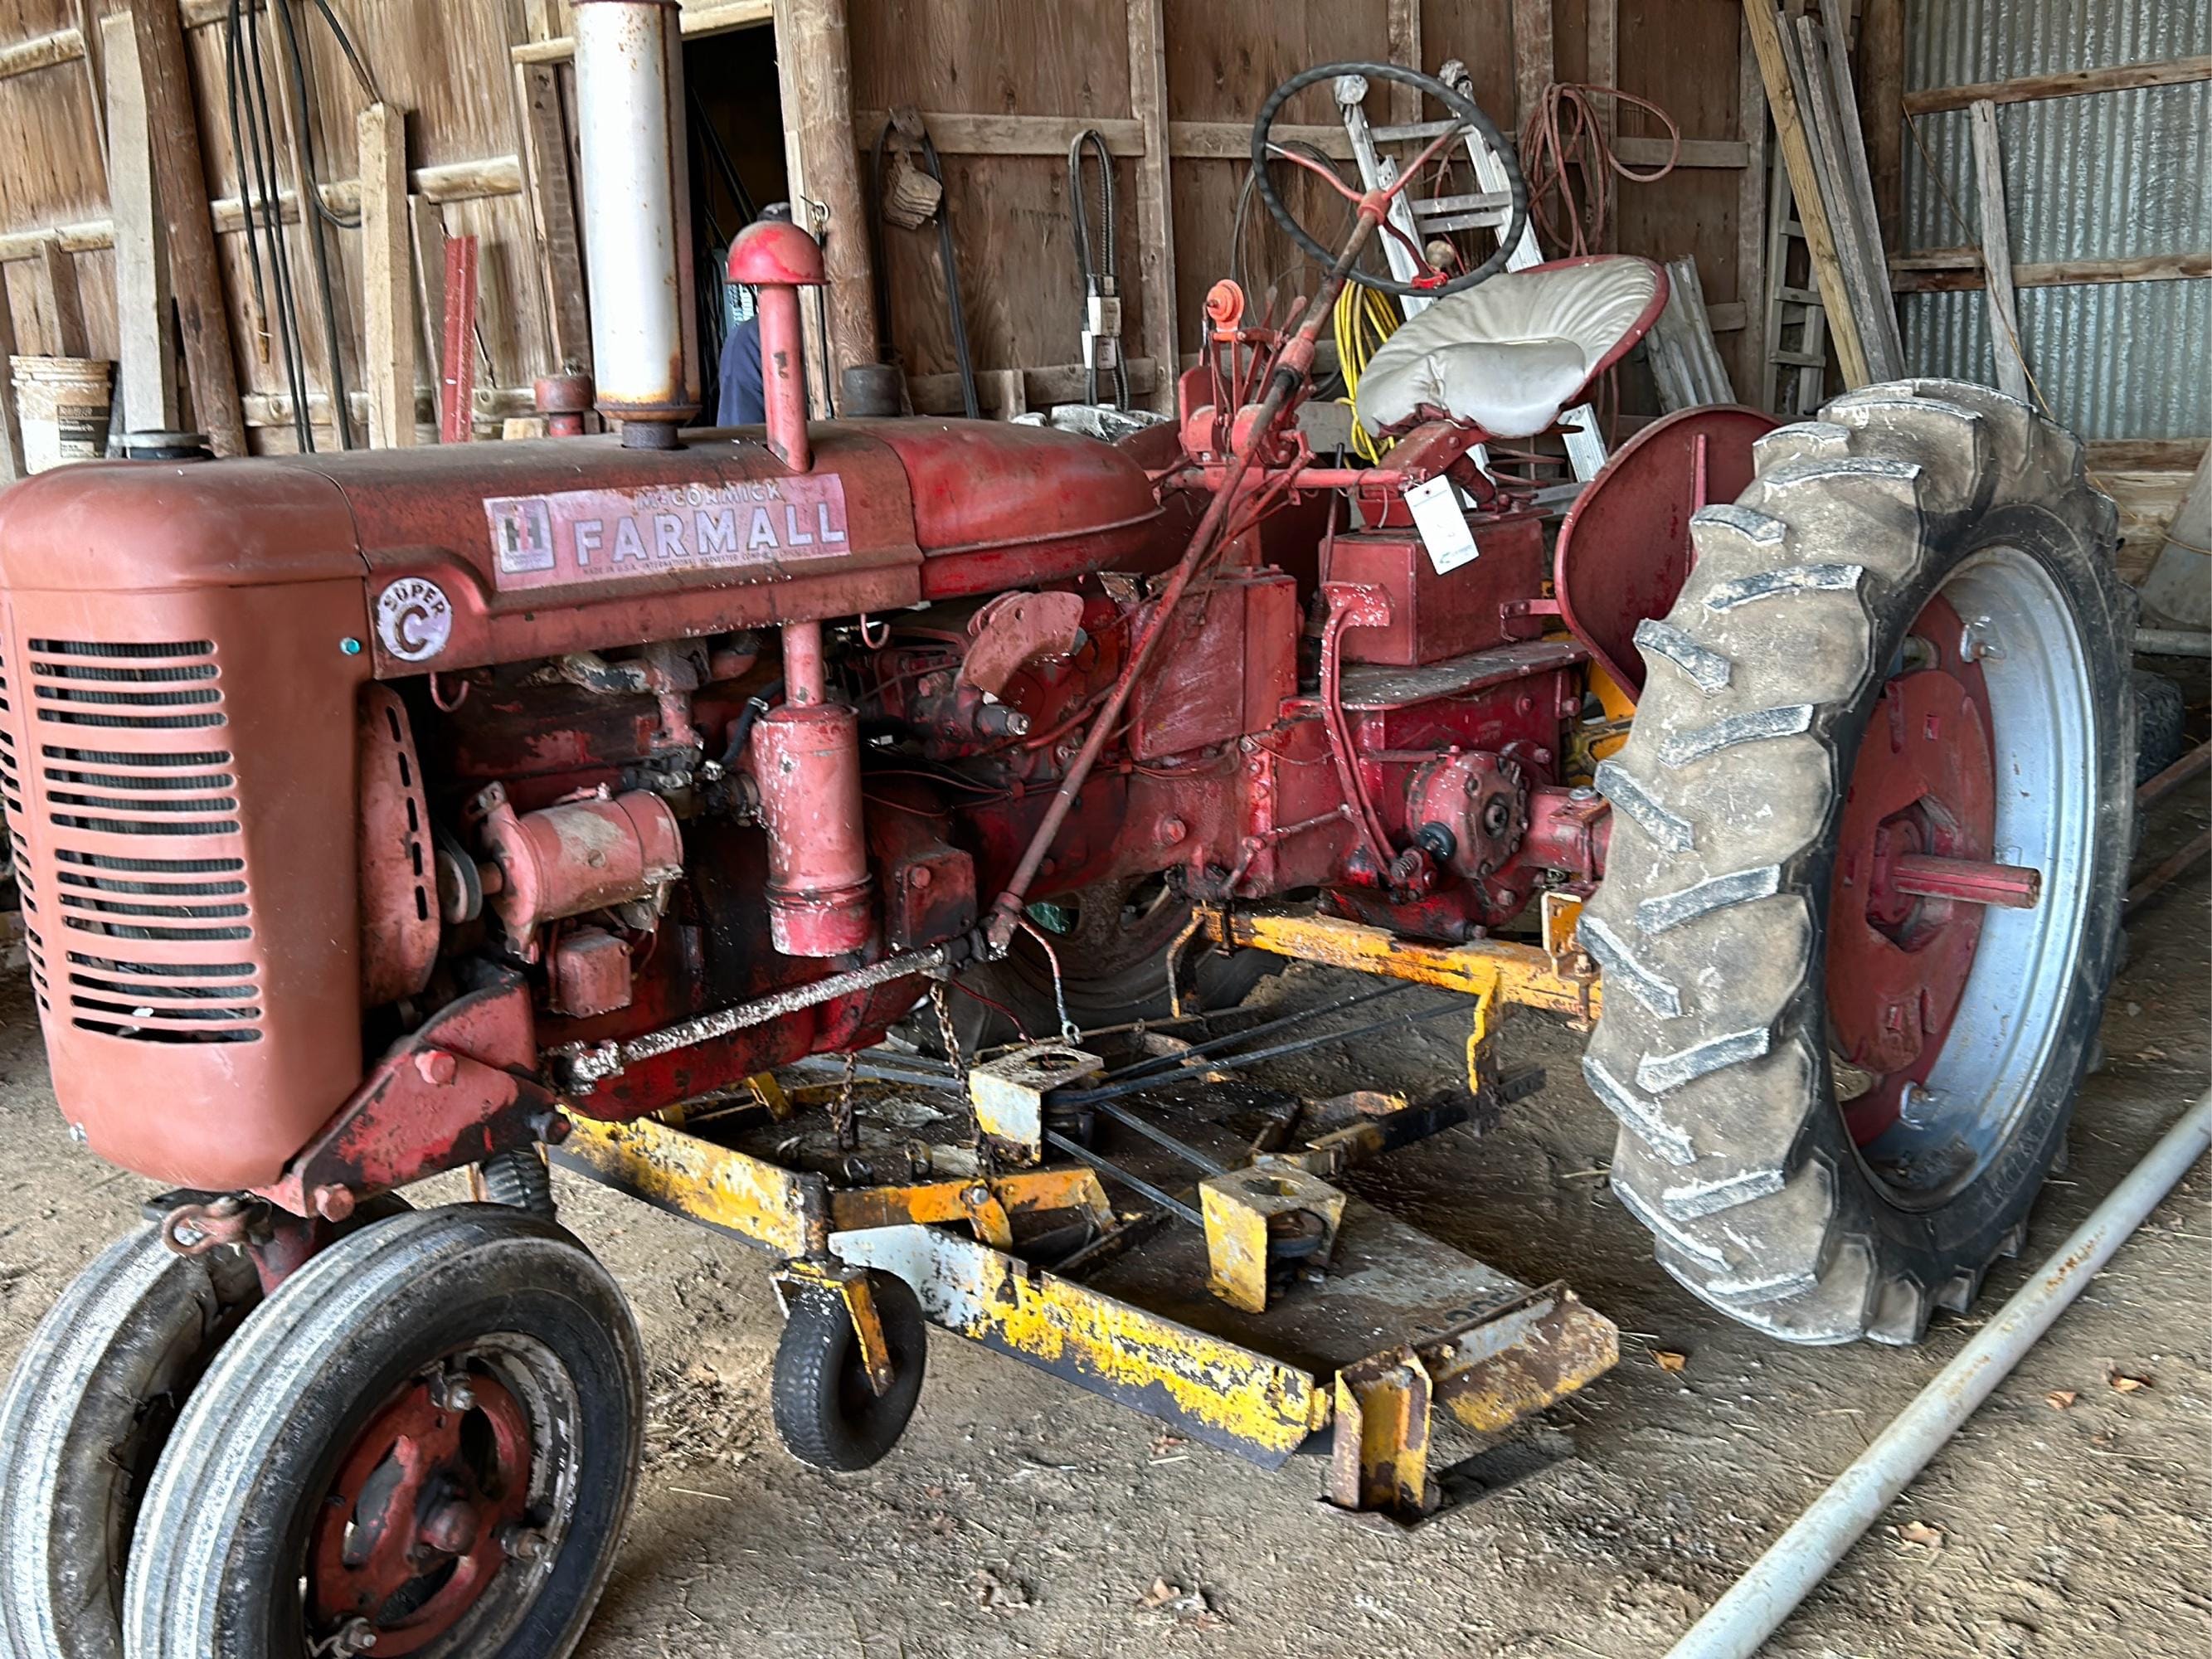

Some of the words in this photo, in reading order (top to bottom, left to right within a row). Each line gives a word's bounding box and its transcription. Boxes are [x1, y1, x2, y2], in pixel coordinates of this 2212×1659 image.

[574, 504, 845, 567] FARMALL
[384, 582, 445, 615] SUPER
[394, 604, 429, 654] C
